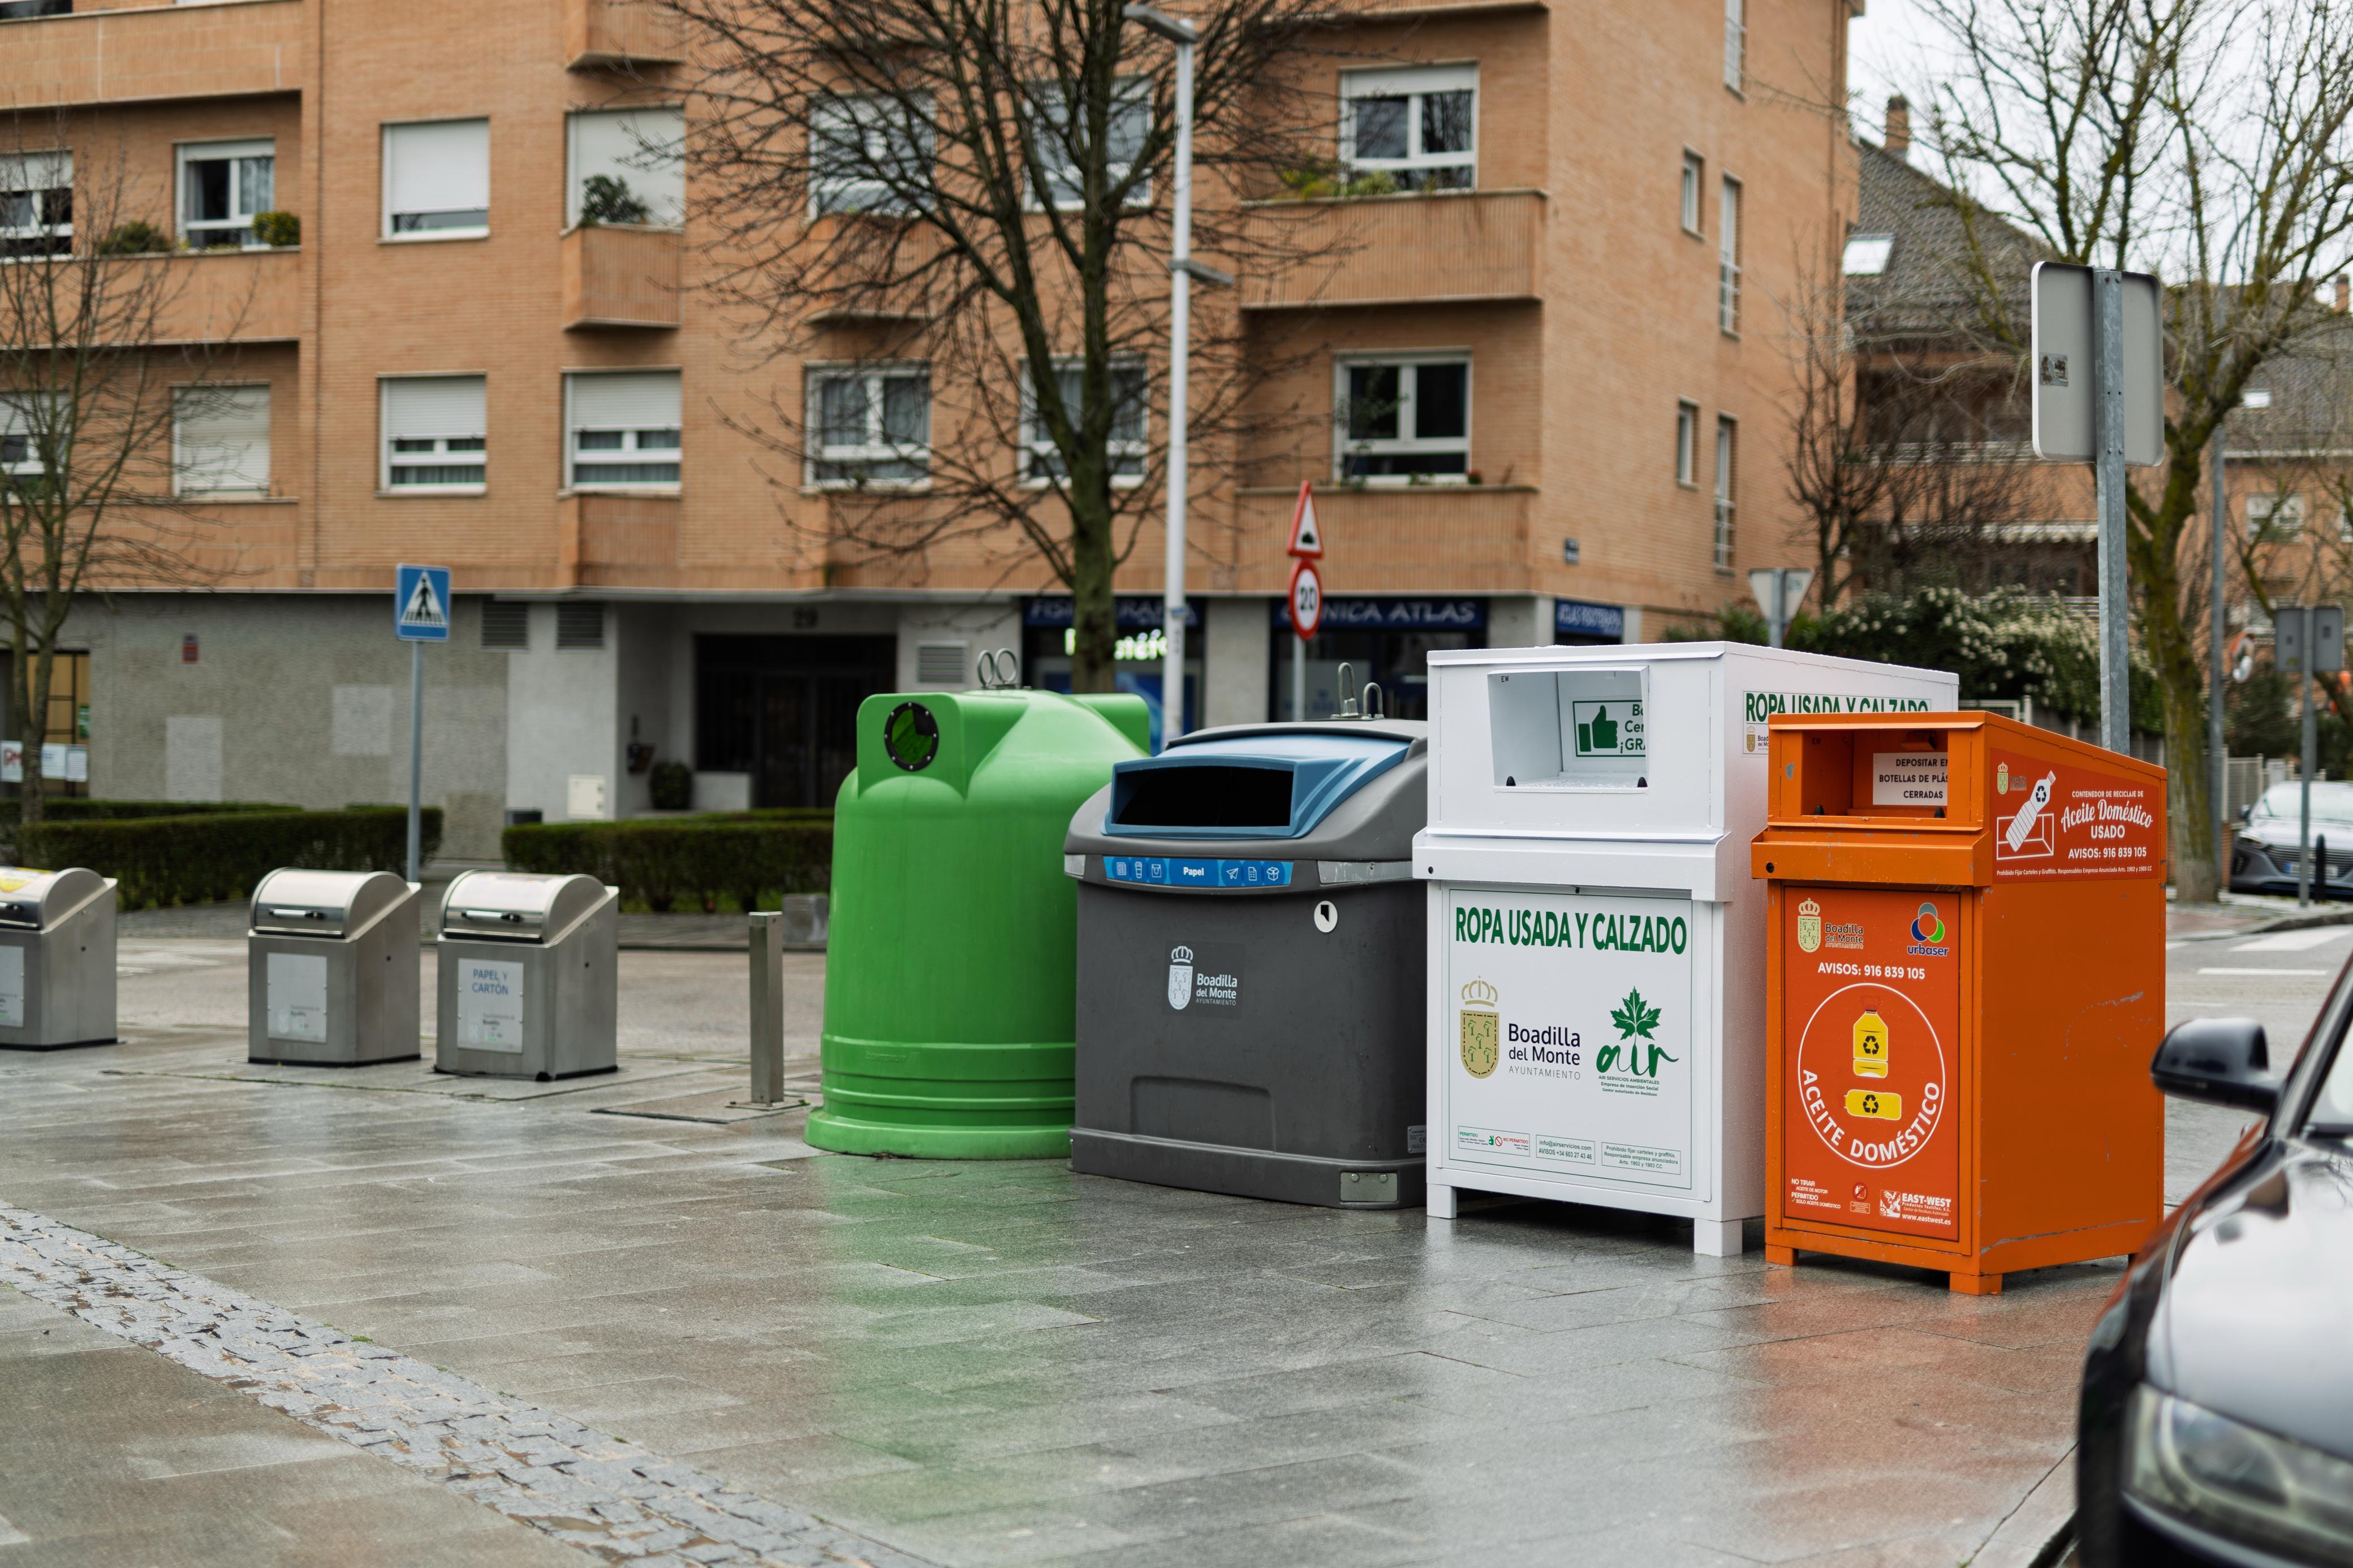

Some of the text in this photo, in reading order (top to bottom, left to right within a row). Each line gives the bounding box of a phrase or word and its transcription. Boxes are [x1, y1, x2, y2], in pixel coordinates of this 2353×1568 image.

[1300, 586, 1317, 611] 20
[1280, 601, 1476, 623] CNICA ATLAS
[1746, 693, 1786, 722] ROPA
[1879, 774, 1916, 783] BOTELLAS
[2061, 799, 2153, 833] Aceite Doméstico
[2091, 825, 2125, 839] USADO
[2068, 847, 2147, 859] AVISOS: 916 839 105
[1183, 867, 1204, 877] Papel
[1456, 907, 1687, 955] ROPA USADA Y CALZADO
[1825, 923, 1863, 934] Boadilla
[1838, 934, 1863, 943] Monte
[1907, 943, 1949, 957] urbaser
[473, 968, 508, 982] PAPEL Y
[1817, 962, 1925, 979] AVISOS: 916 839 105
[1197, 973, 1238, 987] Boadilla
[472, 982, 508, 996] CARTÓN
[1196, 987, 1236, 999] del Monte
[1509, 1023, 1580, 1047] Boadilla
[1509, 1046, 1580, 1065] del Monte
[1596, 1044, 1679, 1078] air
[1509, 1065, 1580, 1080] AYUNTAMIENTO
[1803, 1069, 1940, 1161] ACEITE DOMÉSTICO
[1539, 1140, 1592, 1151] info@airservicios.com
[1791, 1191, 1818, 1200] PERMITIDO
[1902, 1193, 1951, 1208] EAST-WEST
[1902, 1213, 1951, 1225] www.eastwest.es
